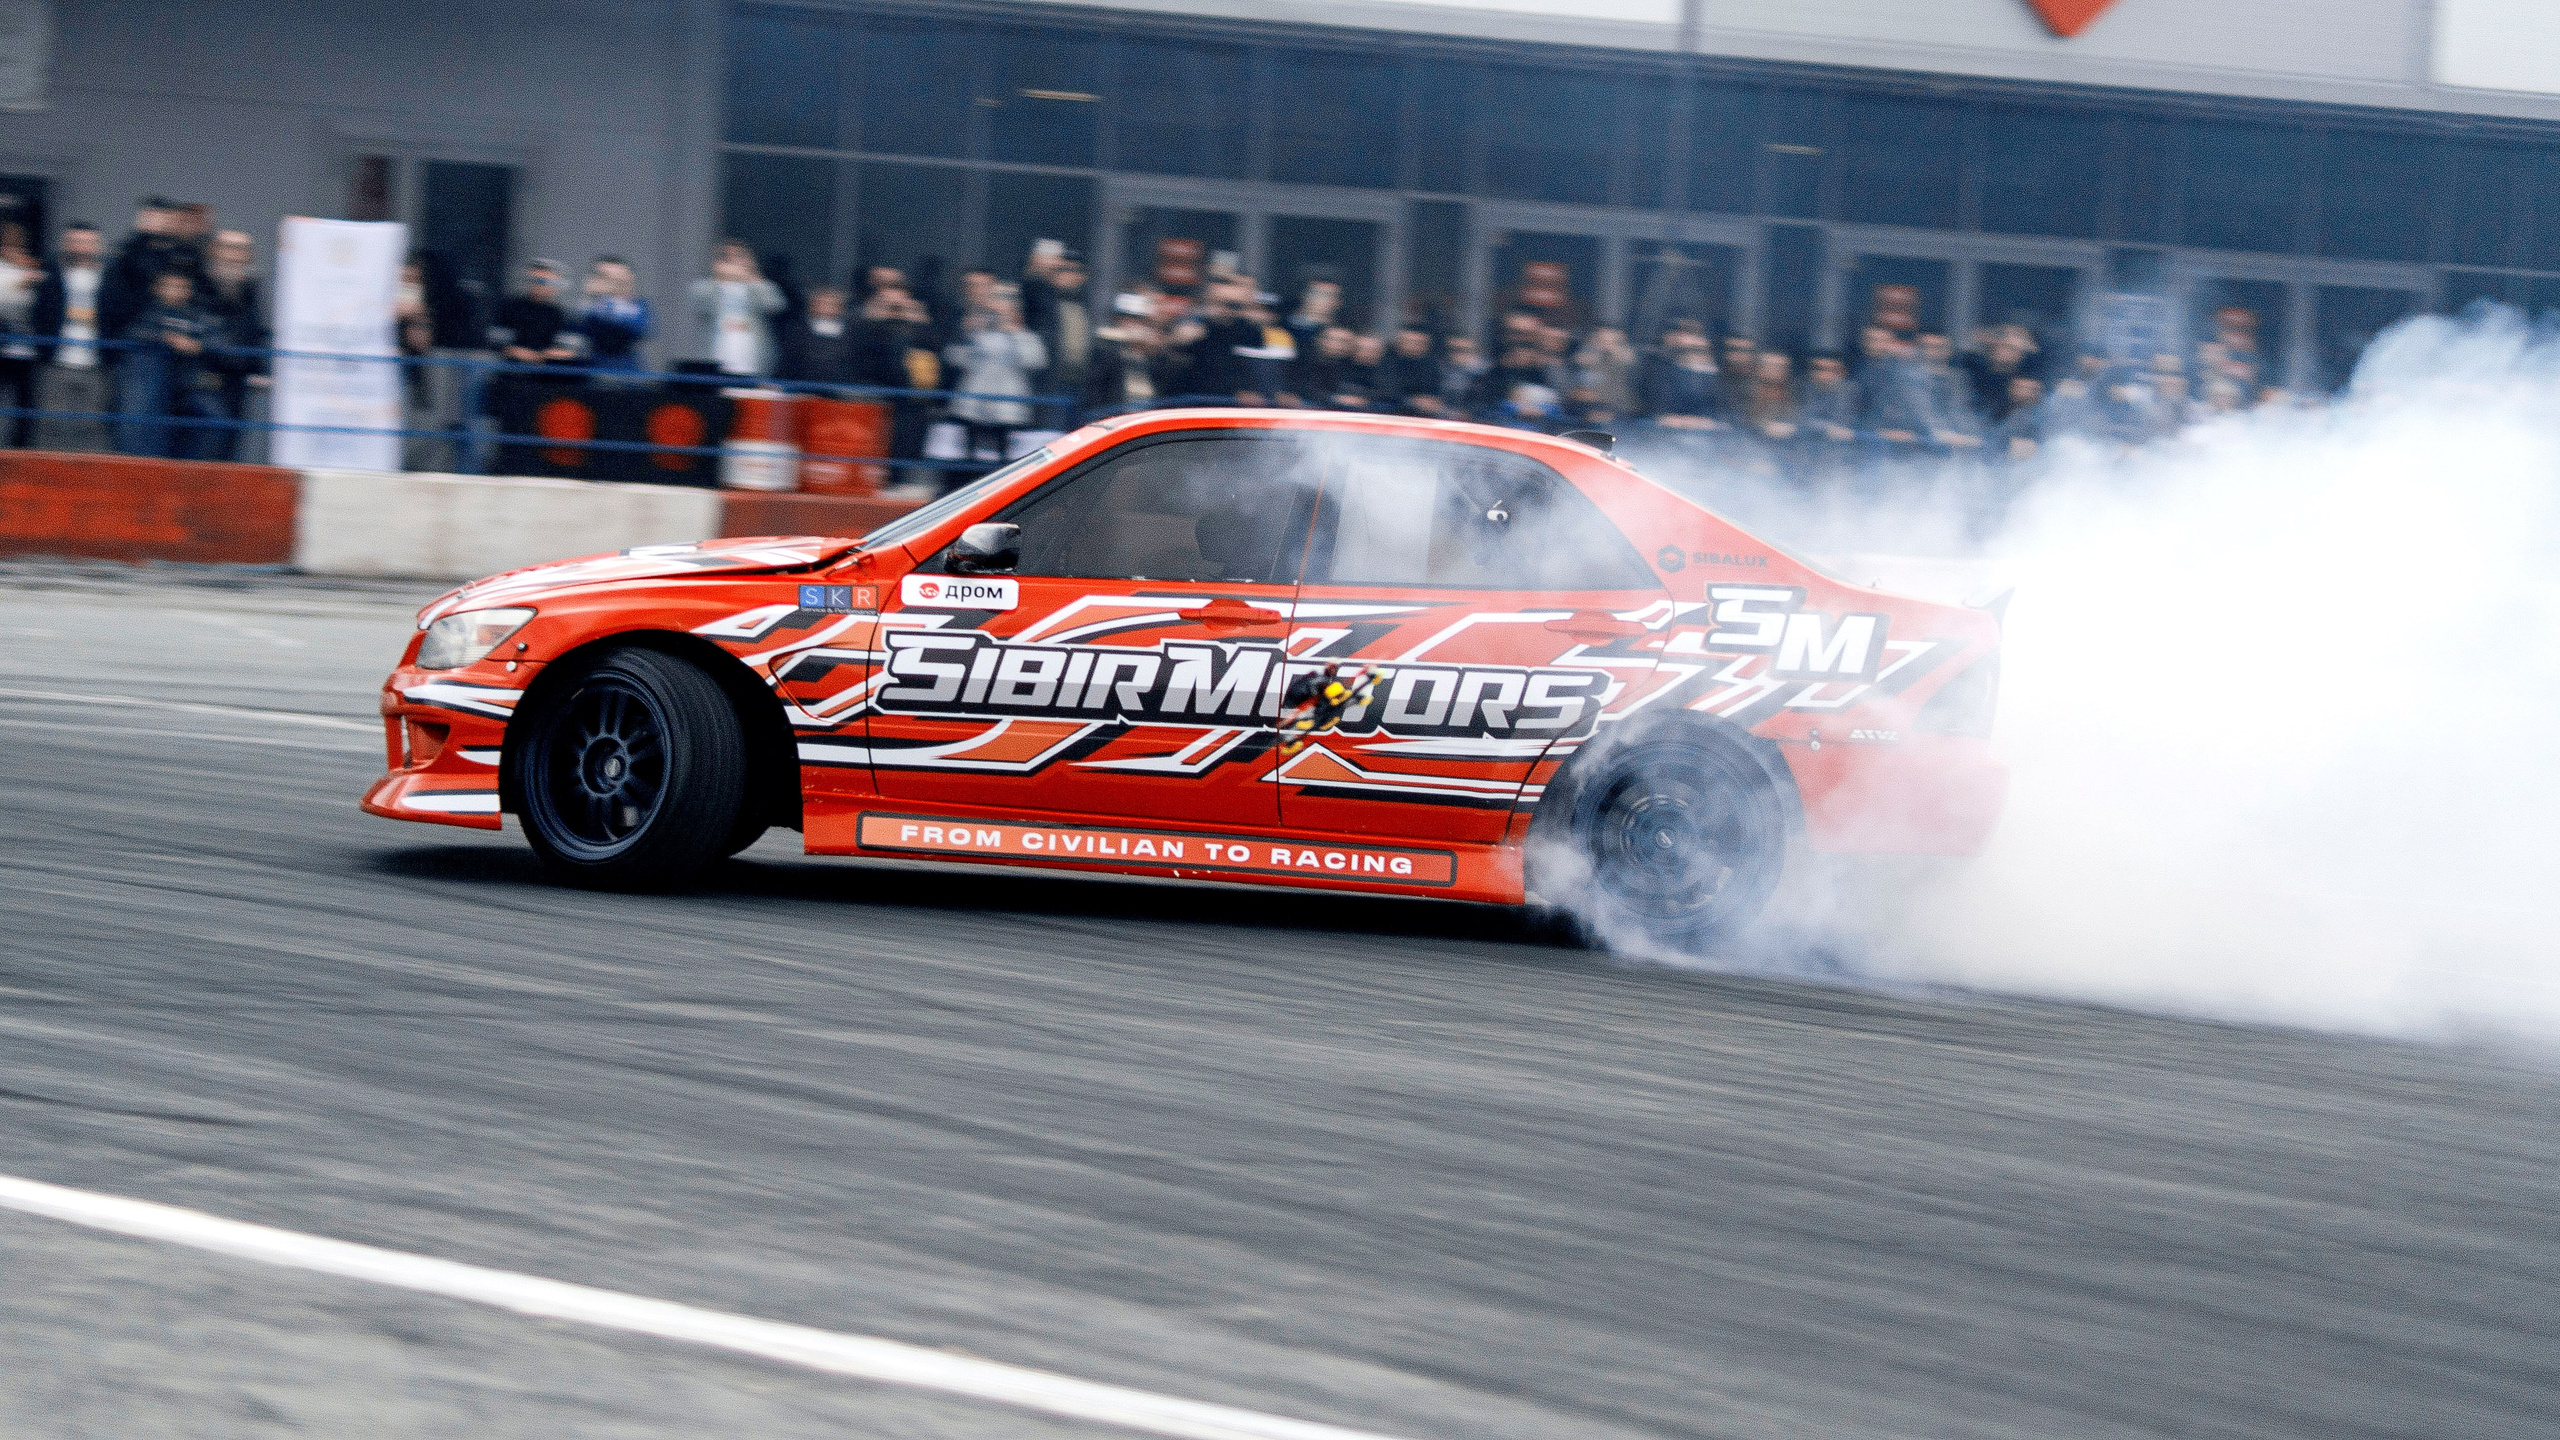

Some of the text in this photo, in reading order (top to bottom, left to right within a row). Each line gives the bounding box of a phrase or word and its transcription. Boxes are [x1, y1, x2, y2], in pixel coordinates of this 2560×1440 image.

[1692, 552, 1768, 567] SIBALUX
[805, 587, 871, 606] SKR
[945, 585, 1003, 602] дром
[881, 633, 1163, 712] SIBIR
[901, 825, 1413, 875] FROM CIVILIAN TO RACING
